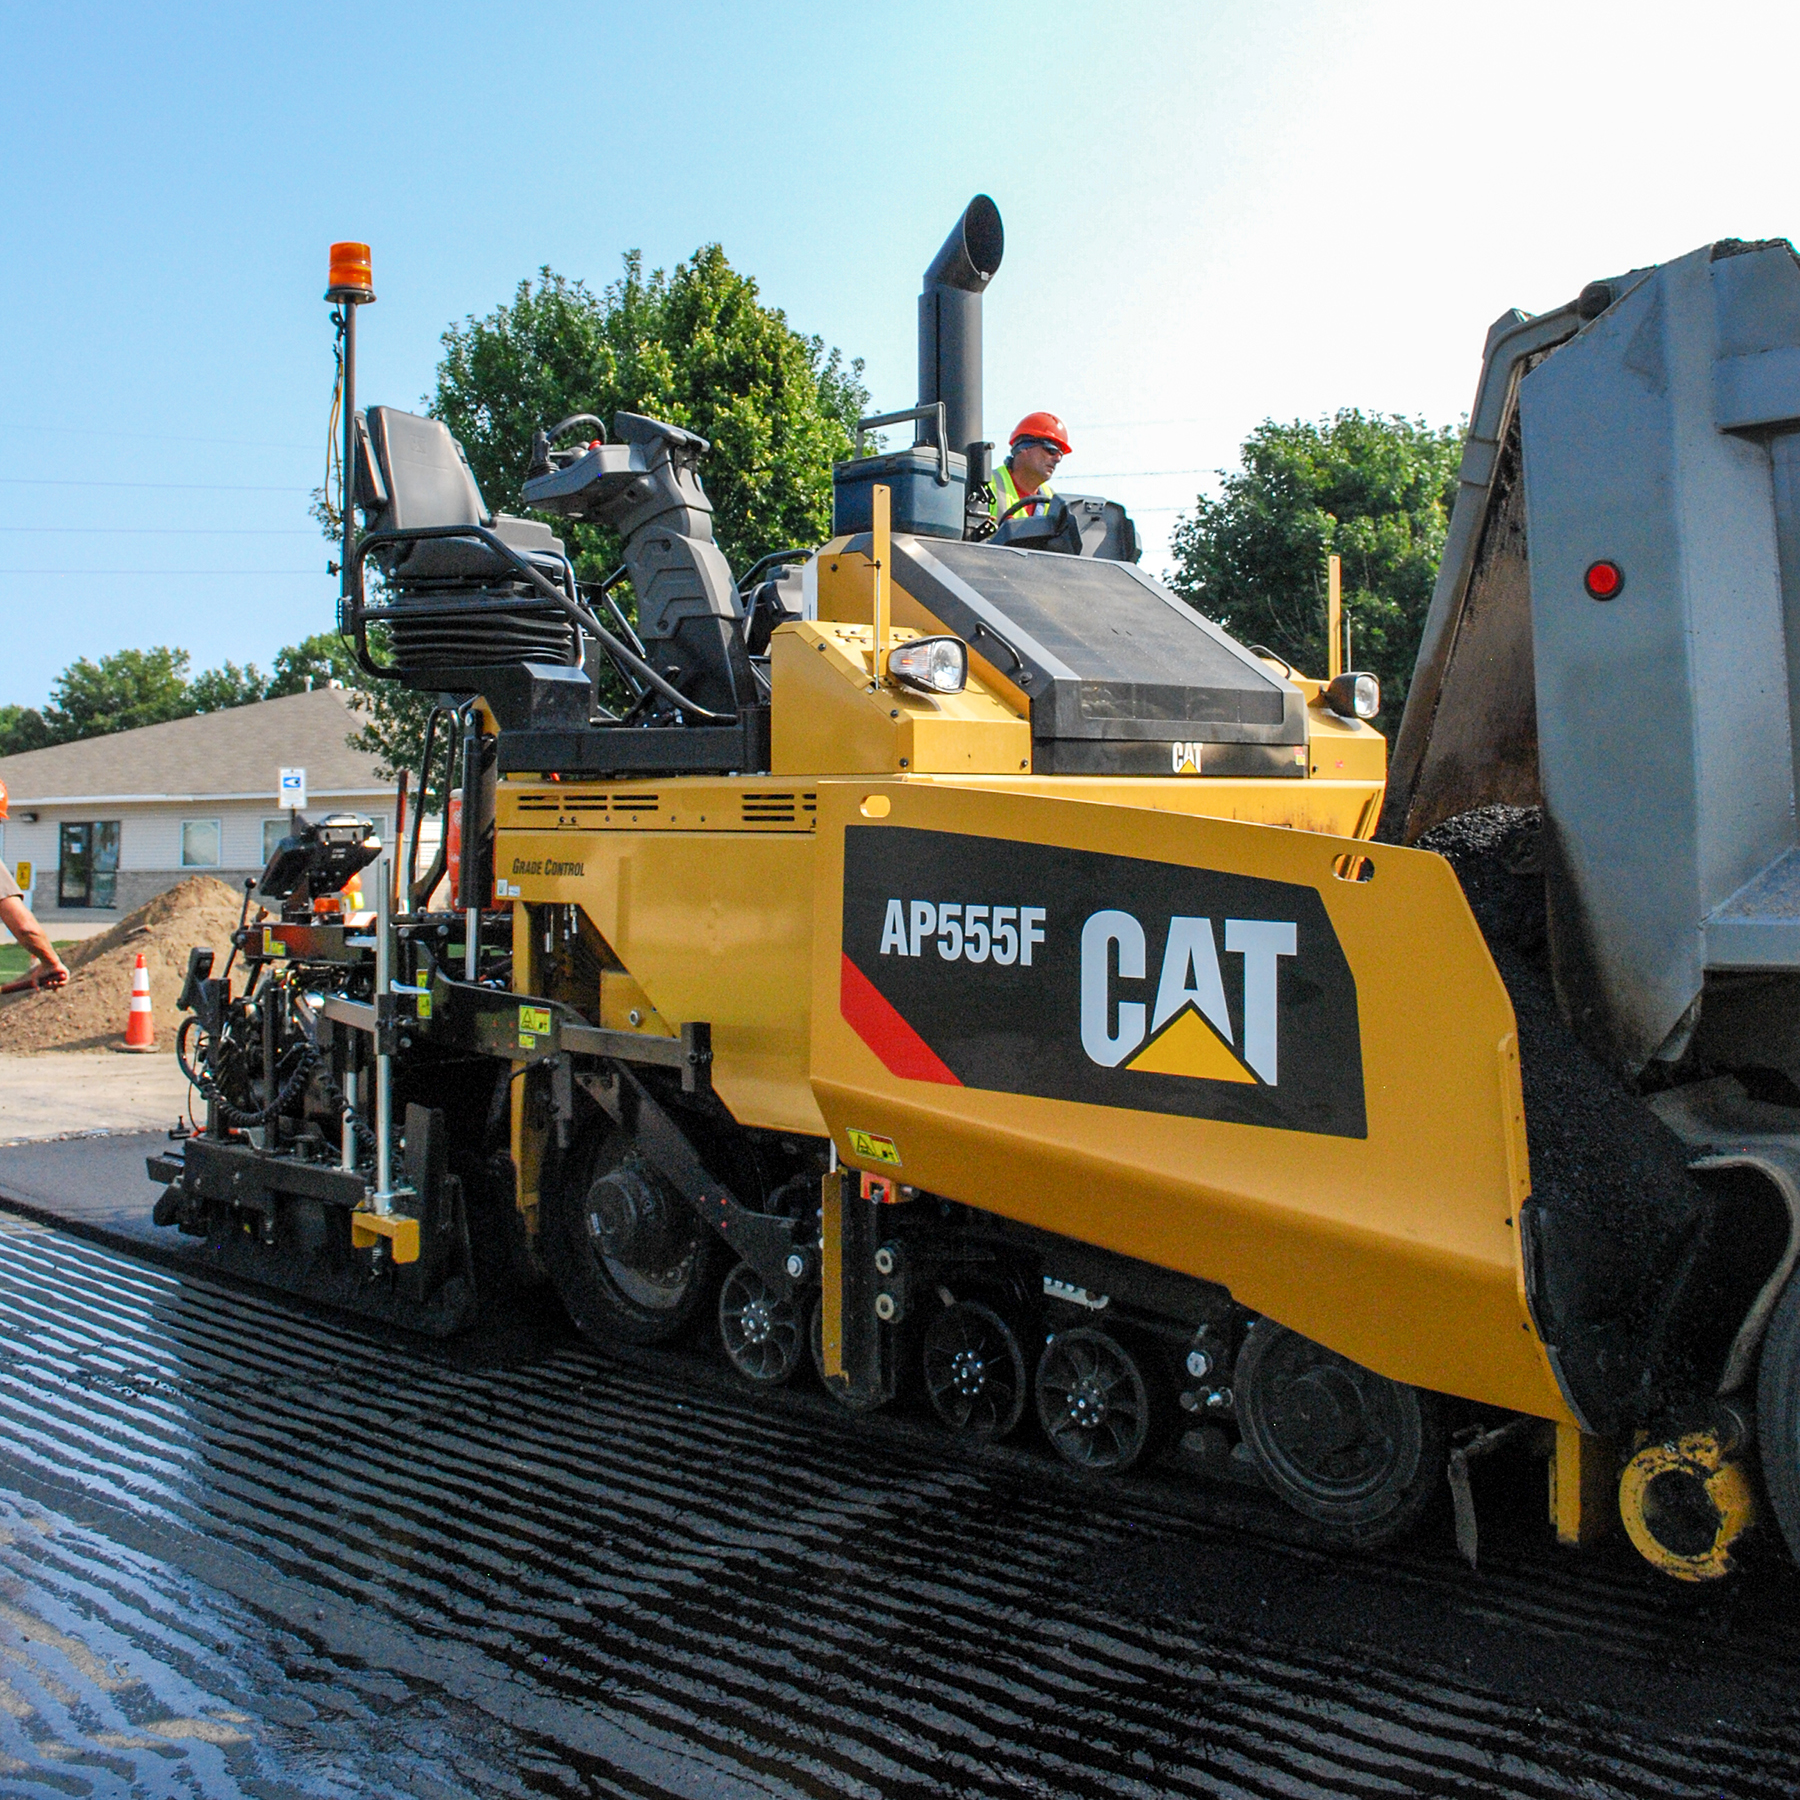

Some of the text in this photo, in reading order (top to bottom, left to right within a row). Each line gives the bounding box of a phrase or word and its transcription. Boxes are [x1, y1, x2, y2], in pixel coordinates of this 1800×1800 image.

[1172, 741, 1203, 773] CAT
[512, 858, 584, 877] GRADE CONTROL
[879, 899, 1046, 966] AP555F
[1080, 909, 1297, 1086] CAT
